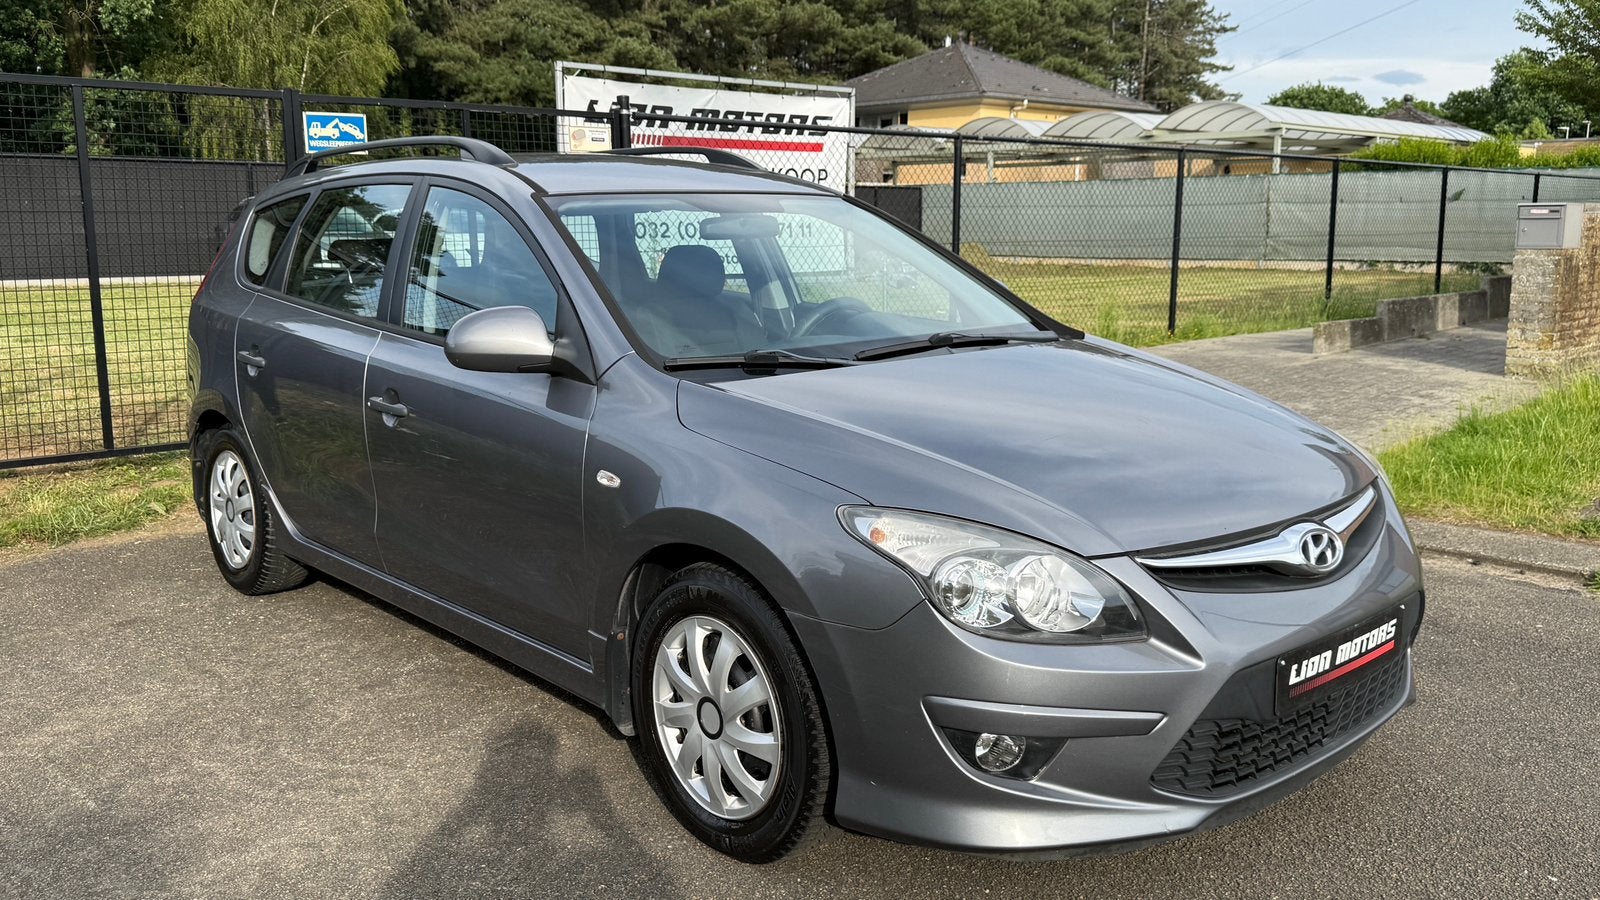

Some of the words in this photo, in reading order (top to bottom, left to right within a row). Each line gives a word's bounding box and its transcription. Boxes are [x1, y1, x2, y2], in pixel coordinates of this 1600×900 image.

[685, 108, 833, 137] MOTORS
[1288, 649, 1333, 686] LION
[1335, 618, 1398, 666] MOTORS
